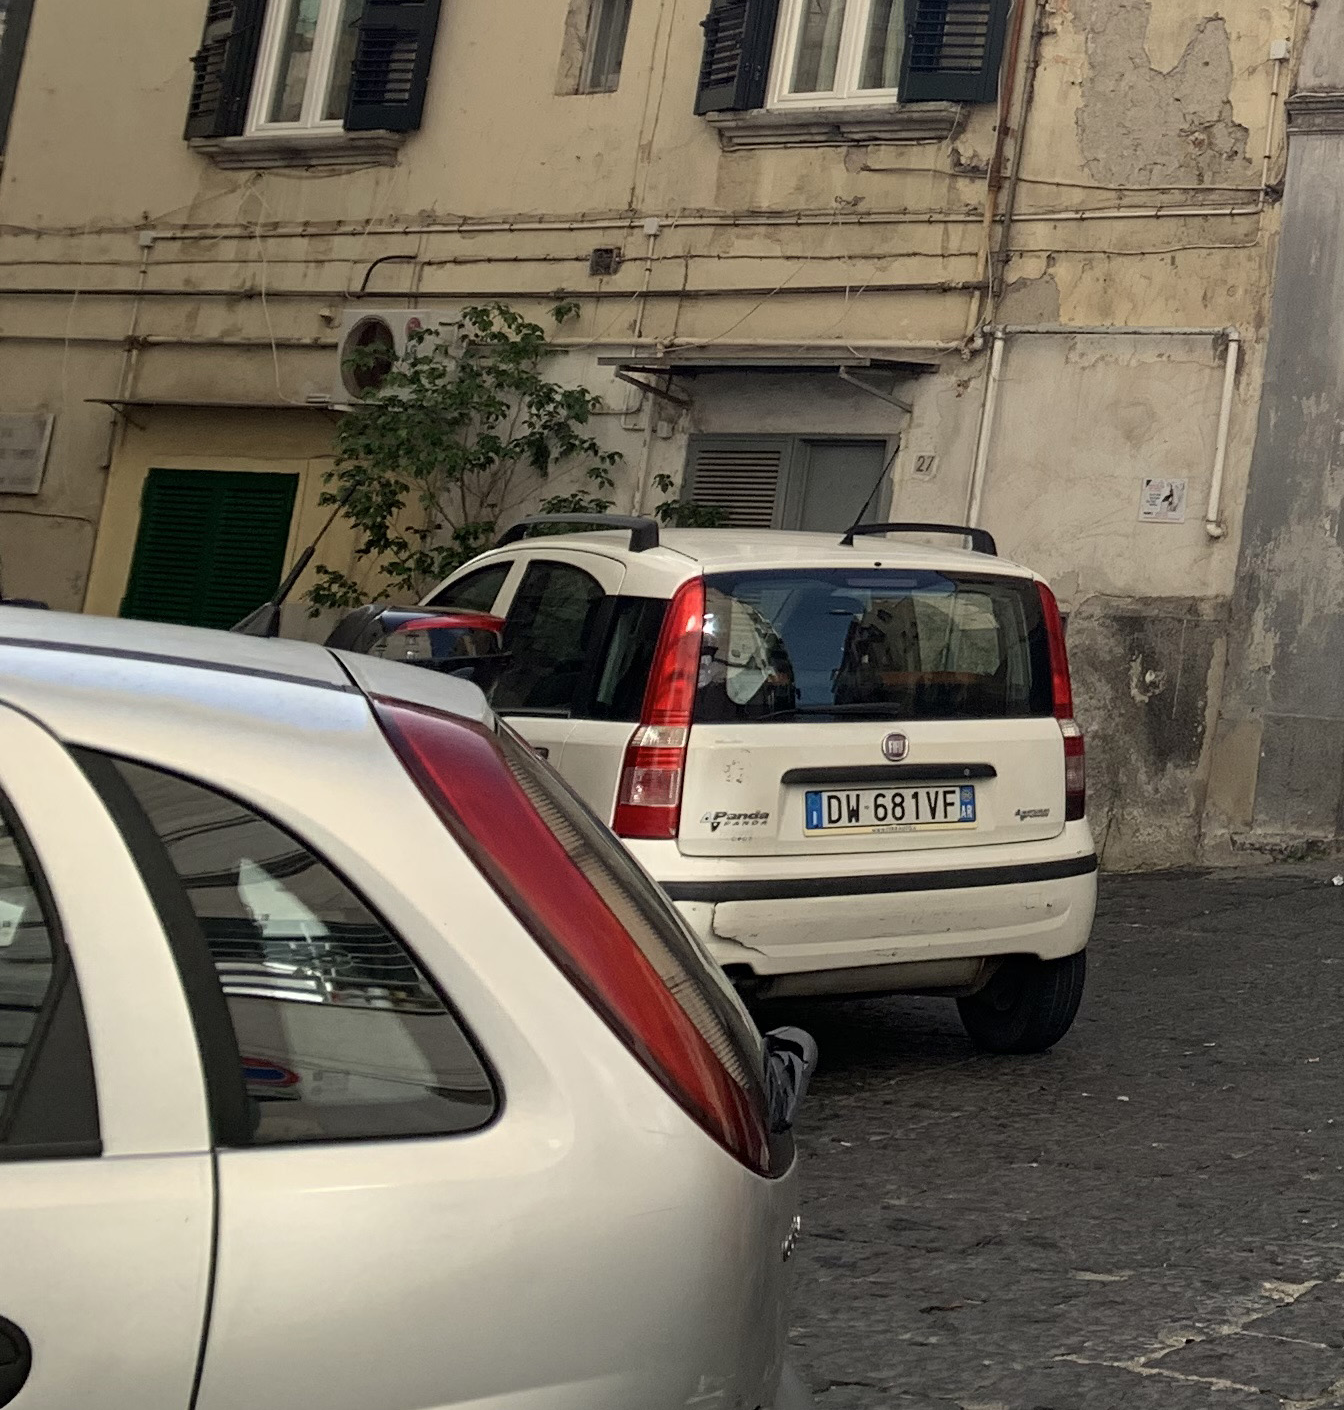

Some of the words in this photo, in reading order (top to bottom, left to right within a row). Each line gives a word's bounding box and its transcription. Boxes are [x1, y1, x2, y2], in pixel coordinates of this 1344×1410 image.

[915, 455, 936, 472] 27
[713, 810, 770, 821] Panda
[960, 803, 973, 819] AR
